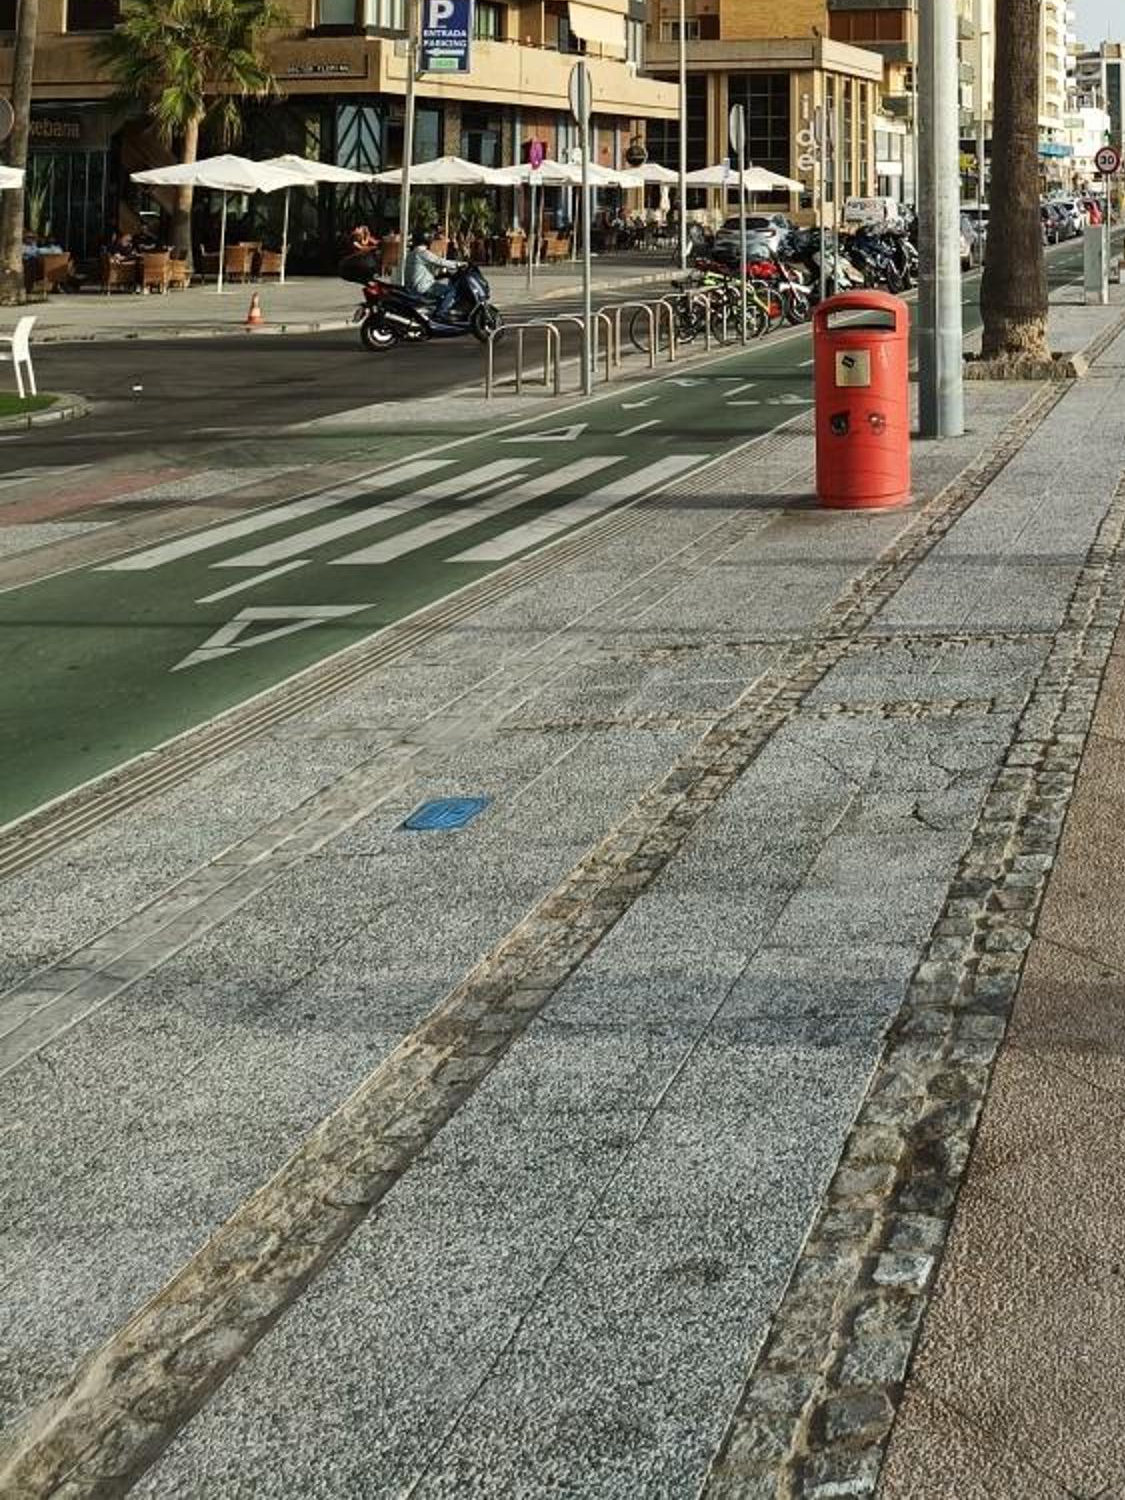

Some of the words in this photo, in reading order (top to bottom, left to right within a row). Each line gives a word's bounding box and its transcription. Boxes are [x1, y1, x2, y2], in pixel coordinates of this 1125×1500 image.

[428, 0, 455, 28] P
[423, 29, 467, 37] ENTRADA
[423, 39, 467, 47] PARKING
[1099, 154, 1116, 165] 30
